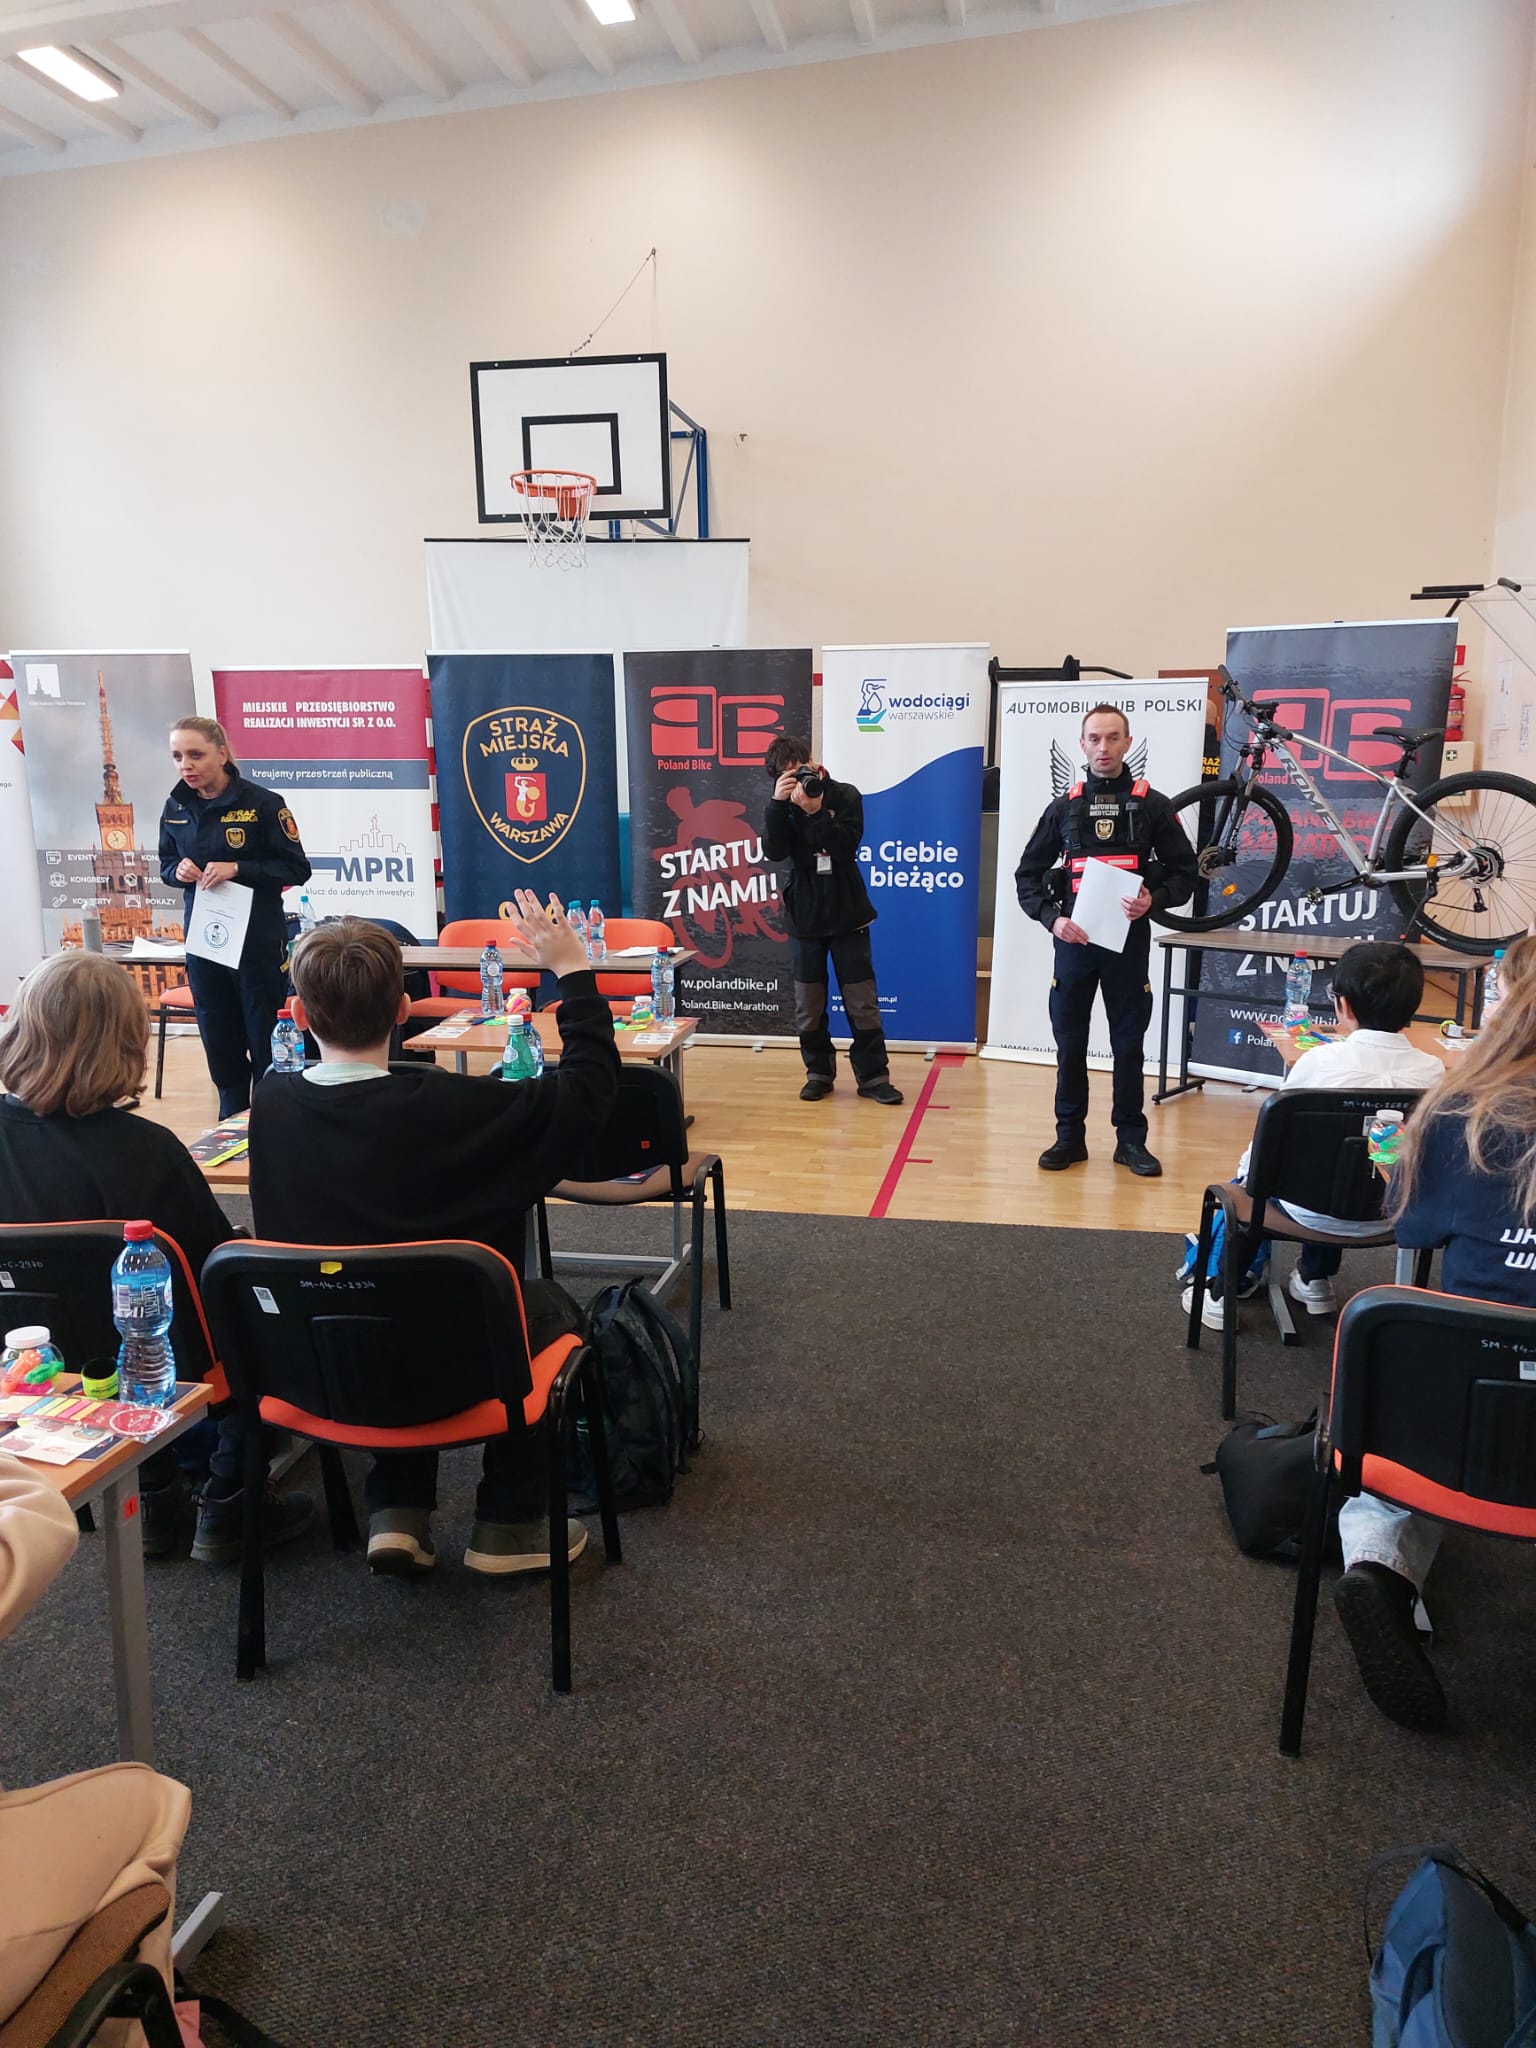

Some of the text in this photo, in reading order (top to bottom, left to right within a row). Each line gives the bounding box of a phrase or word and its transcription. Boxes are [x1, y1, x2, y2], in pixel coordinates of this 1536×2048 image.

[243, 701, 395, 714] MIEJSKIE PRZEDSIĘBIORSTWO
[889, 693, 970, 711] wodociągi
[1006, 699, 1202, 714] AUTOMOBILUB POLSKI
[888, 709, 954, 721] warszawskie
[244, 717, 294, 728] REALIZACJI
[297, 717, 350, 728] INWESTYCJI
[368, 717, 376, 728] Z
[489, 716, 560, 737] STRAŻ
[480, 734, 569, 757] MIEJSKA
[658, 759, 712, 770] Poland Bike
[1201, 756, 1221, 767] RAŻ
[252, 768, 394, 781] kreujemy przestrzeń publiczną
[488, 811, 570, 844] WARSZAWA
[67, 853, 97, 862] EVENTY
[659, 836, 769, 879] STARTU
[879, 840, 959, 863] Ciebie
[335, 856, 415, 883] MPRI
[70, 876, 110, 885] KONGRESY
[870, 865, 965, 893] bieżąco
[305, 886, 416, 898] klucz do udanych inwestycji
[662, 872, 778, 919] Z NAMI!
[145, 897, 177, 906] POKAZY
